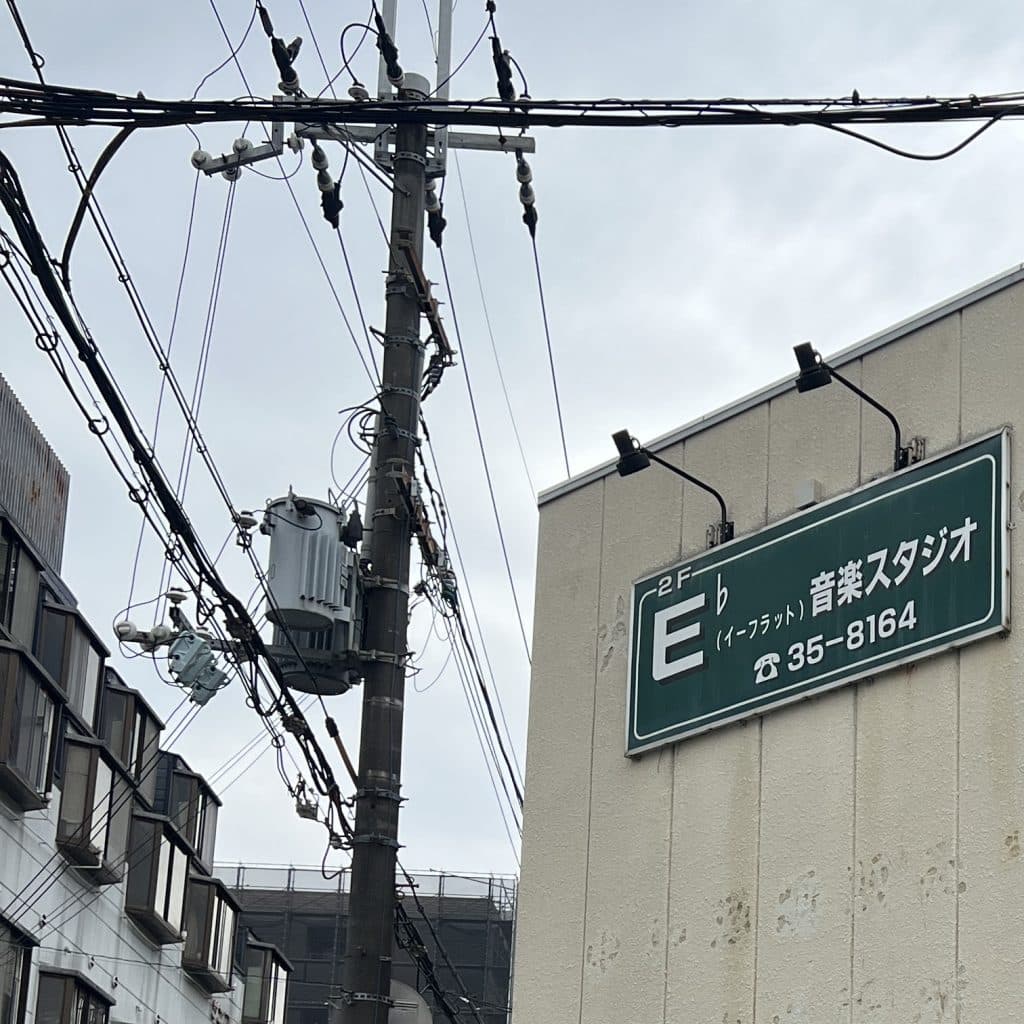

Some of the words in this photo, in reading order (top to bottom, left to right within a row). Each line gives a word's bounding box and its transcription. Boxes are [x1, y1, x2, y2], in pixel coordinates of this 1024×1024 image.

[657, 567, 692, 597] 2F
[809, 516, 978, 617] 音楽スタジオ
